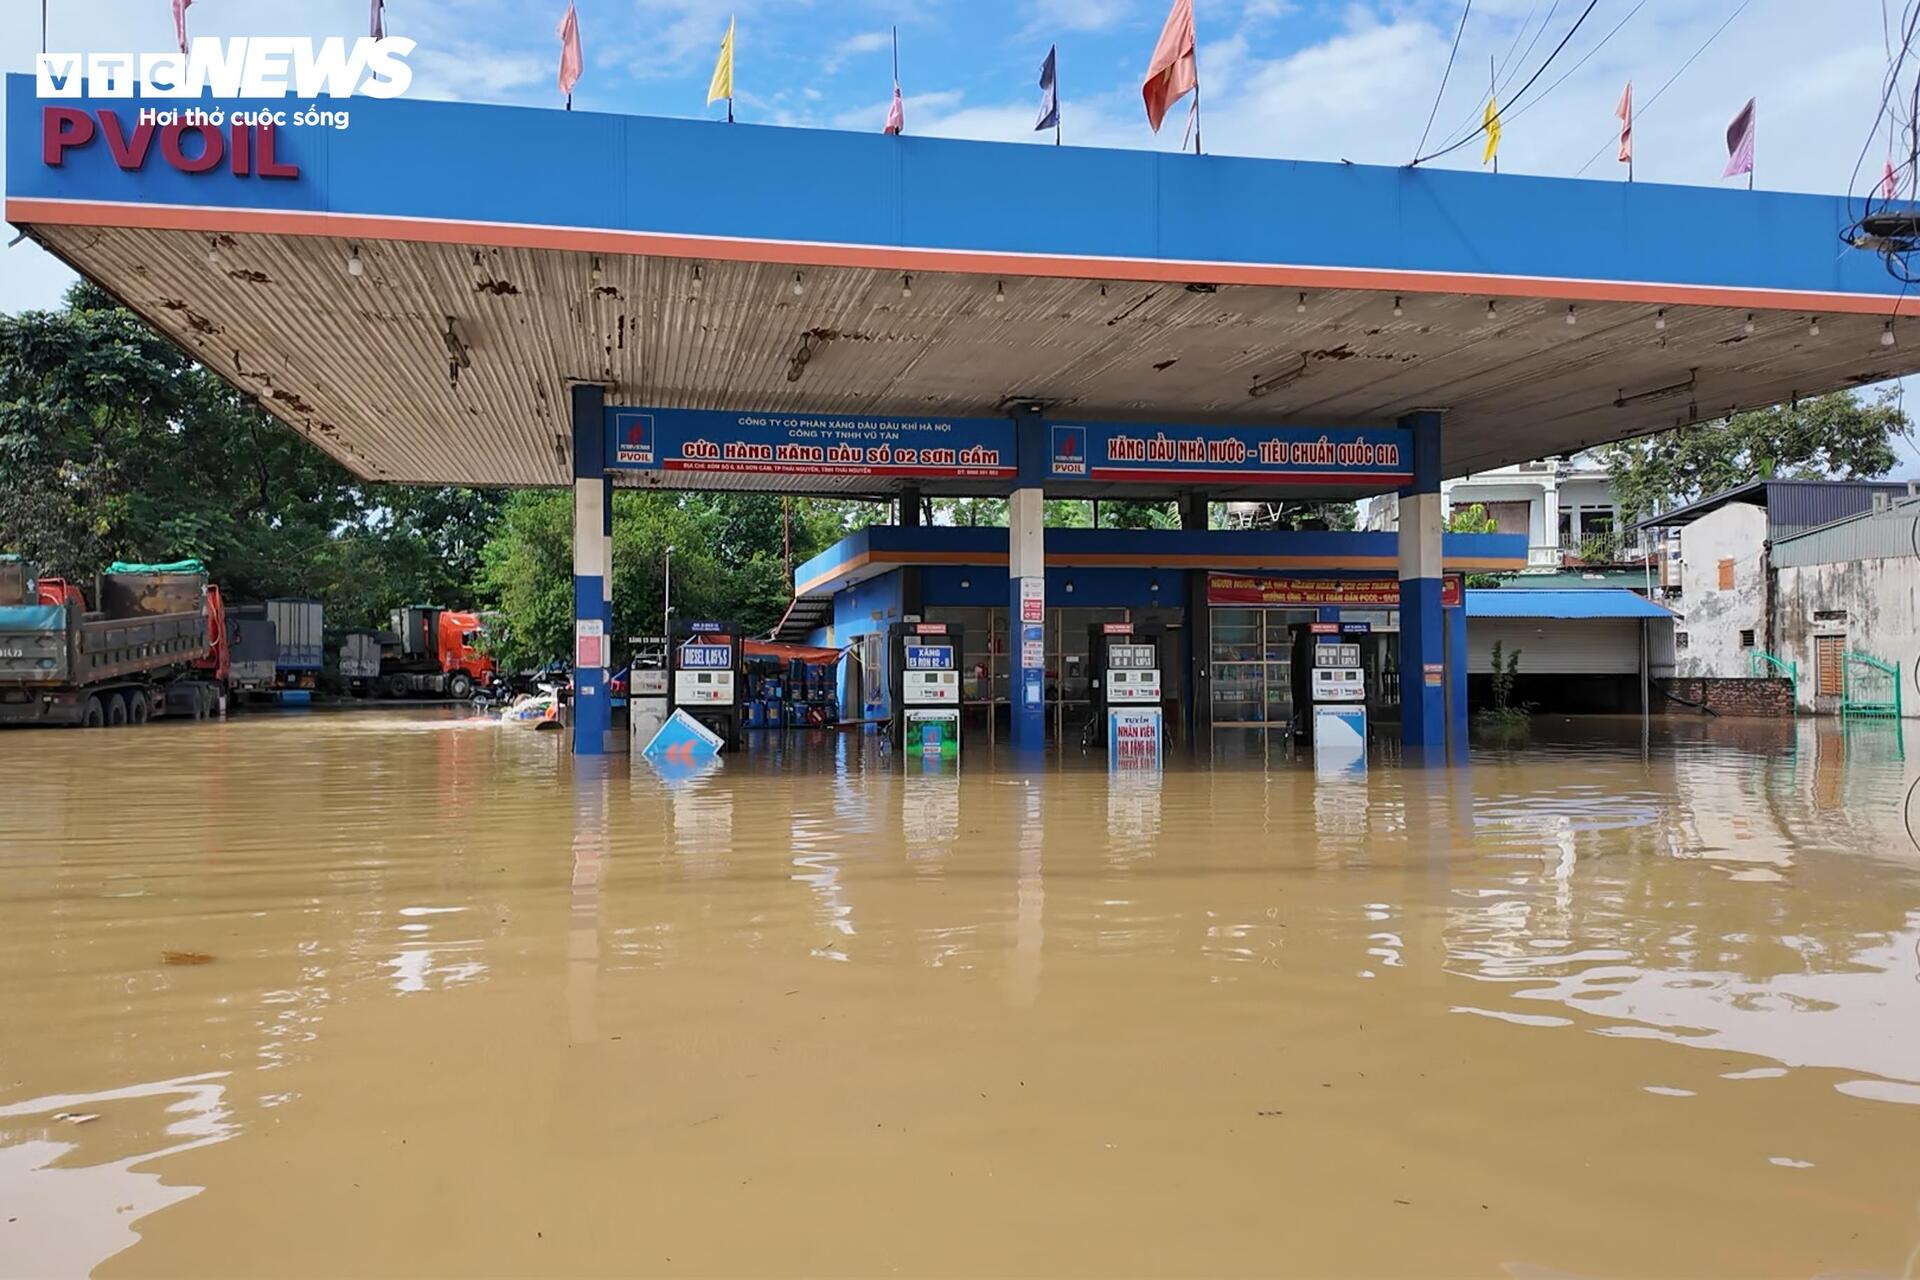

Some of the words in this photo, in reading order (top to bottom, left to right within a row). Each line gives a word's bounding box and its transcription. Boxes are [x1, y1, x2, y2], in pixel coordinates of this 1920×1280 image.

[42, 105, 299, 180] PVOIL
[738, 417, 767, 427] CÔNG
[769, 419, 782, 427] TY
[788, 428, 818, 438] CÔNG
[820, 430, 833, 438] TY
[835, 431, 862, 439] TNHH
[683, 439, 720, 458] CỬA
[724, 441, 772, 461] HÀNG
[776, 443, 823, 462] XĂNG
[827, 442, 862, 462] DẦU
[867, 443, 891, 464] SỐ
[895, 448, 916, 464] 02
[921, 449, 956, 465] SƠN
[960, 445, 999, 465] CẨM
[1108, 436, 1145, 461] XĂNG
[1148, 432, 1176, 462] DẦU
[1178, 437, 1206, 462] NHÀ
[1208, 437, 1245, 463] NƯỚC
[1259, 438, 1288, 464] TIÊU
[1290, 435, 1335, 465] CHUẨN
[1337, 437, 1373, 466] QUỐC
[1375, 443, 1399, 466] GIA
[620, 452, 651, 461] PVOIL
[1055, 464, 1082, 472] PVOIL
[685, 648, 705, 665] DIESEL
